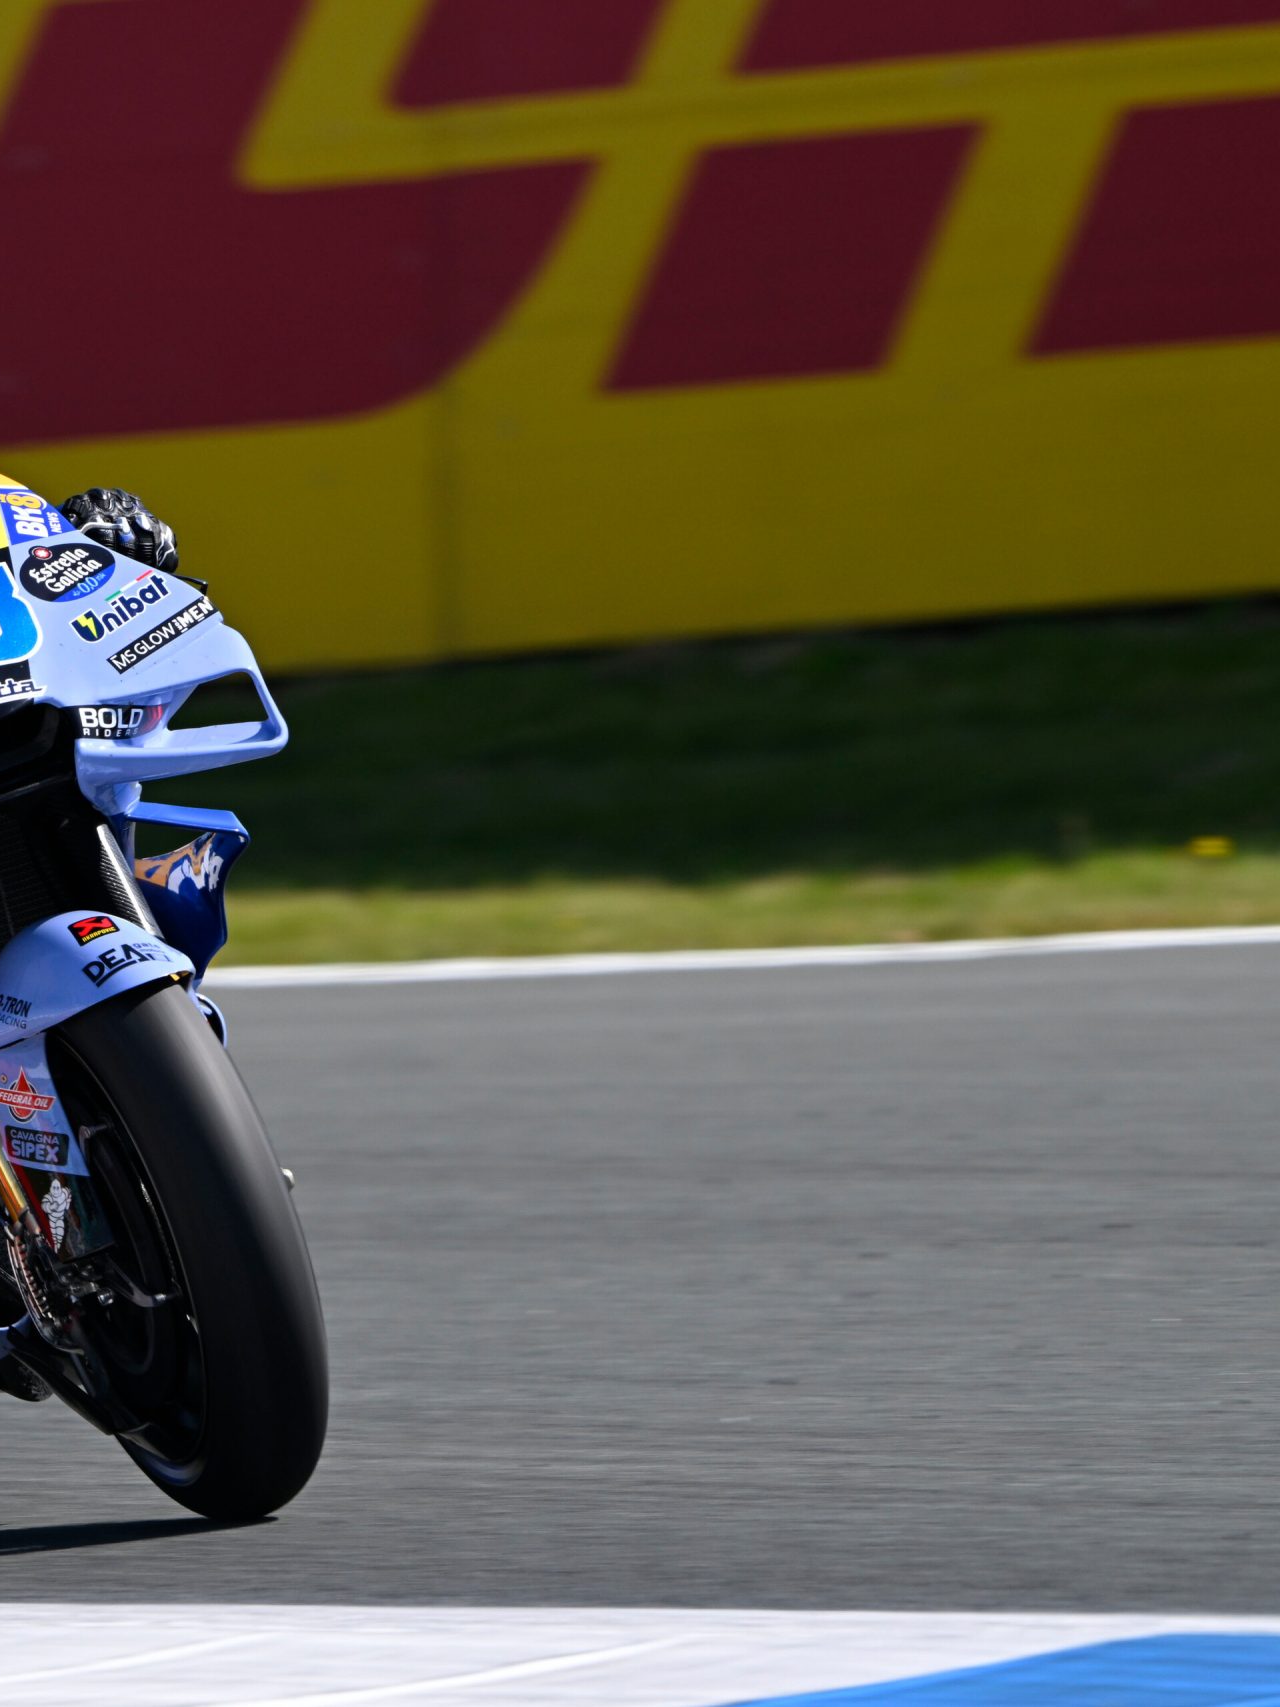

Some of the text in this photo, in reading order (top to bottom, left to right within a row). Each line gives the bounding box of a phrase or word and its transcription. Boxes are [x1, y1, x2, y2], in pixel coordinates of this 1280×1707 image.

[6, 491, 49, 538] BK8
[49, 511, 63, 534] NEWS
[28, 548, 90, 583] Estrella
[45, 559, 103, 593] Galicia
[69, 573, 171, 644] Unibat
[110, 649, 137, 671] MS
[133, 623, 176, 655] GLOW
[178, 596, 214, 629] MEN
[78, 707, 144, 729] BOLD
[82, 727, 139, 738] RIDERS
[33, 1097, 49, 1108] OIL
[9, 1129, 60, 1145] CAVAGNA
[10, 1139, 60, 1163] SIPEX
